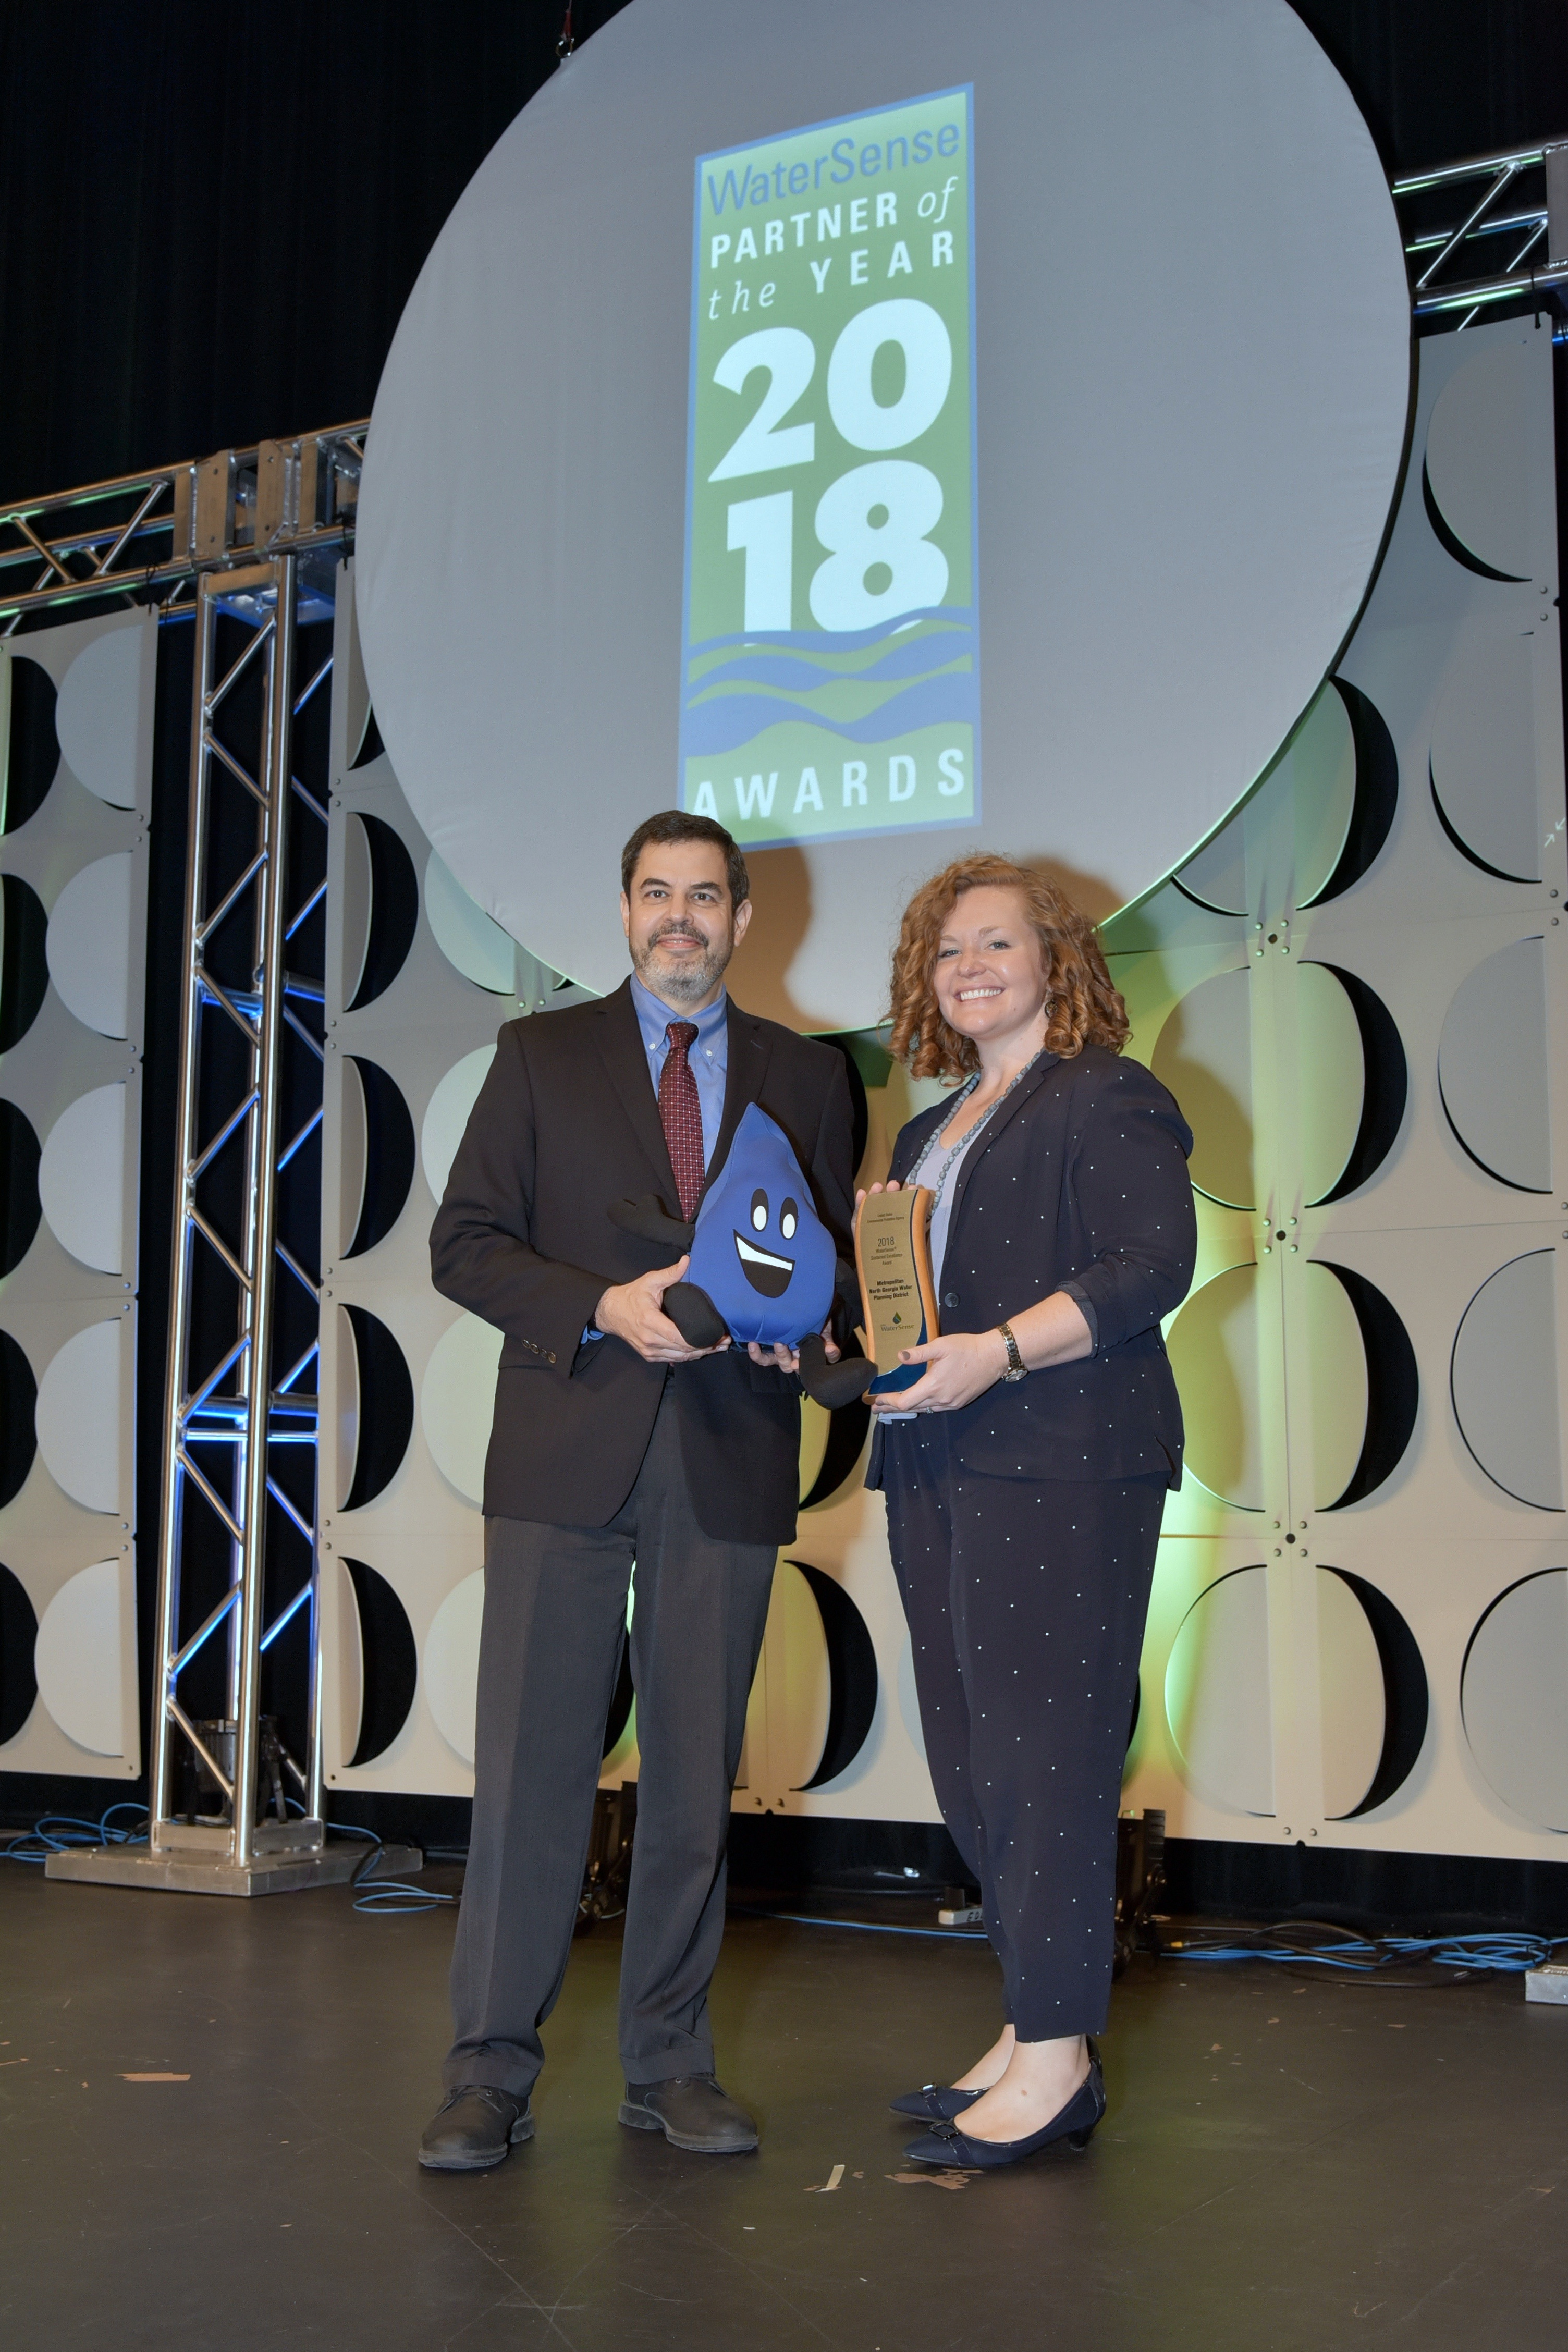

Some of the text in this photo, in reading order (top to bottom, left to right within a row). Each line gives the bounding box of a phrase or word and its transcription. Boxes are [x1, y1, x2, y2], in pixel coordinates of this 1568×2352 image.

[707, 123, 960, 215] WaterSense
[711, 176, 959, 269] PARTNER of
[708, 231, 954, 320] the YEAR
[708, 298, 952, 483] 20
[727, 459, 949, 646] 18
[693, 748, 965, 822] AWARDS
[877, 1236, 894, 1246] 2018
